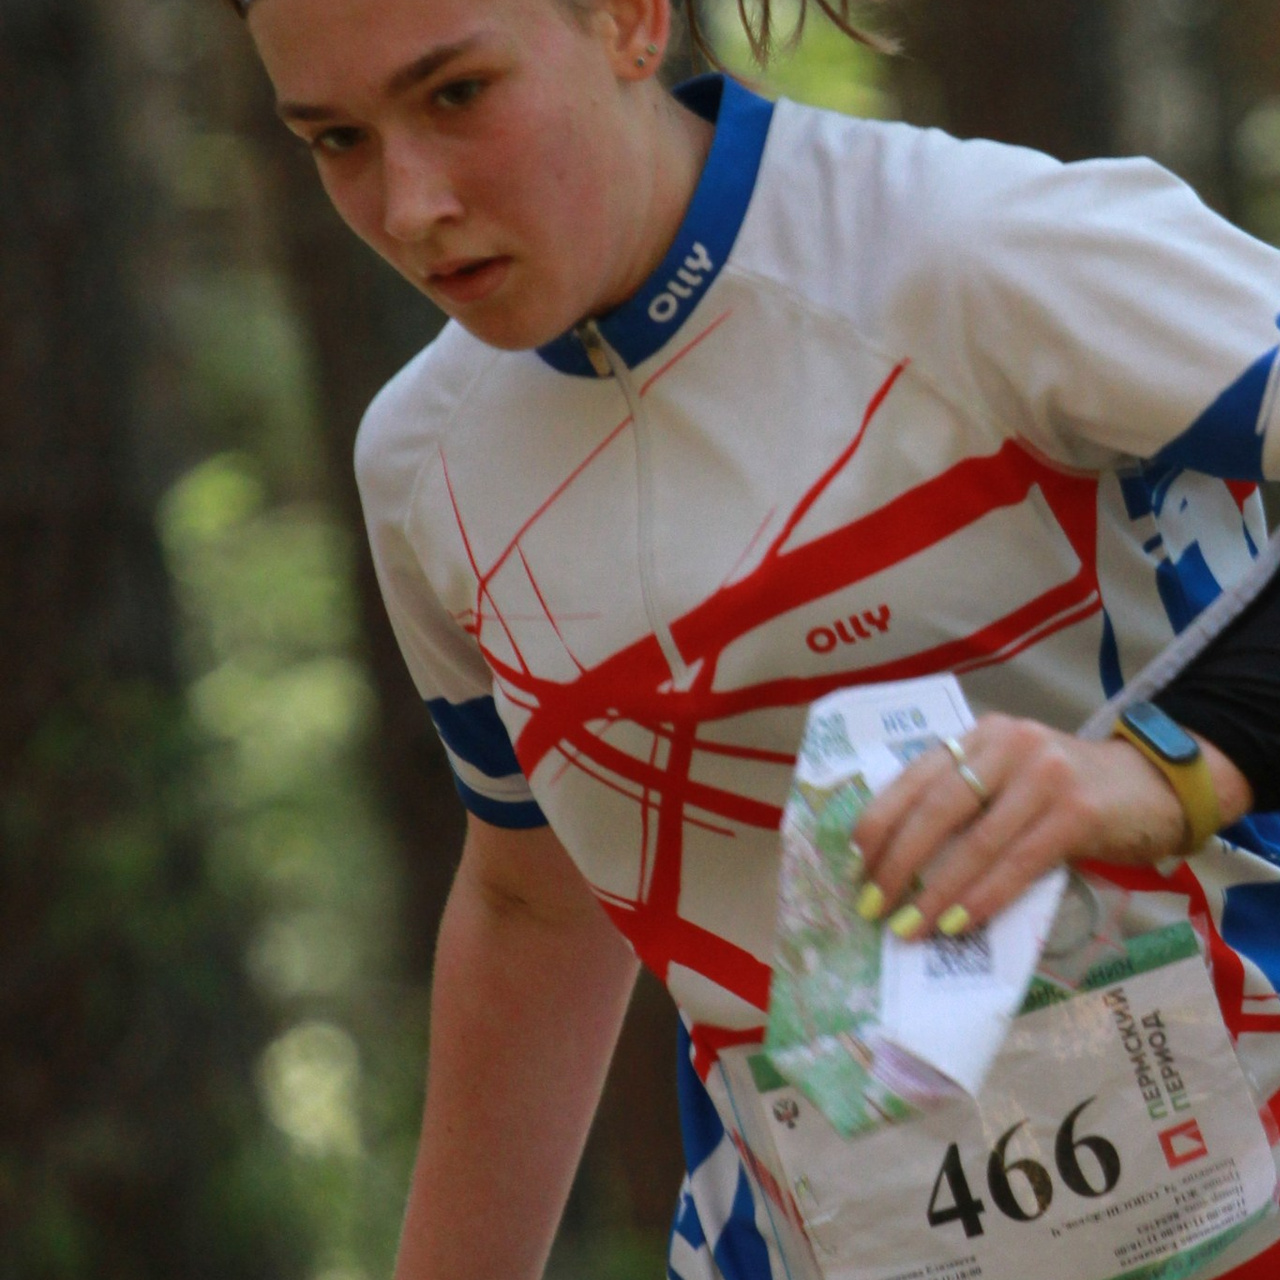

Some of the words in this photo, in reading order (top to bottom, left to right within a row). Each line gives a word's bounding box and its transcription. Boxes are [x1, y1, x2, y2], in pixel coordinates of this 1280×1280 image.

[648, 241, 713, 322] OLLY
[806, 602, 890, 654] OLLY
[1102, 987, 1168, 1120] ПЕРМСКИЙ
[1141, 1008, 1191, 1111] ПЕРИОД
[927, 1095, 1121, 1239] 466
